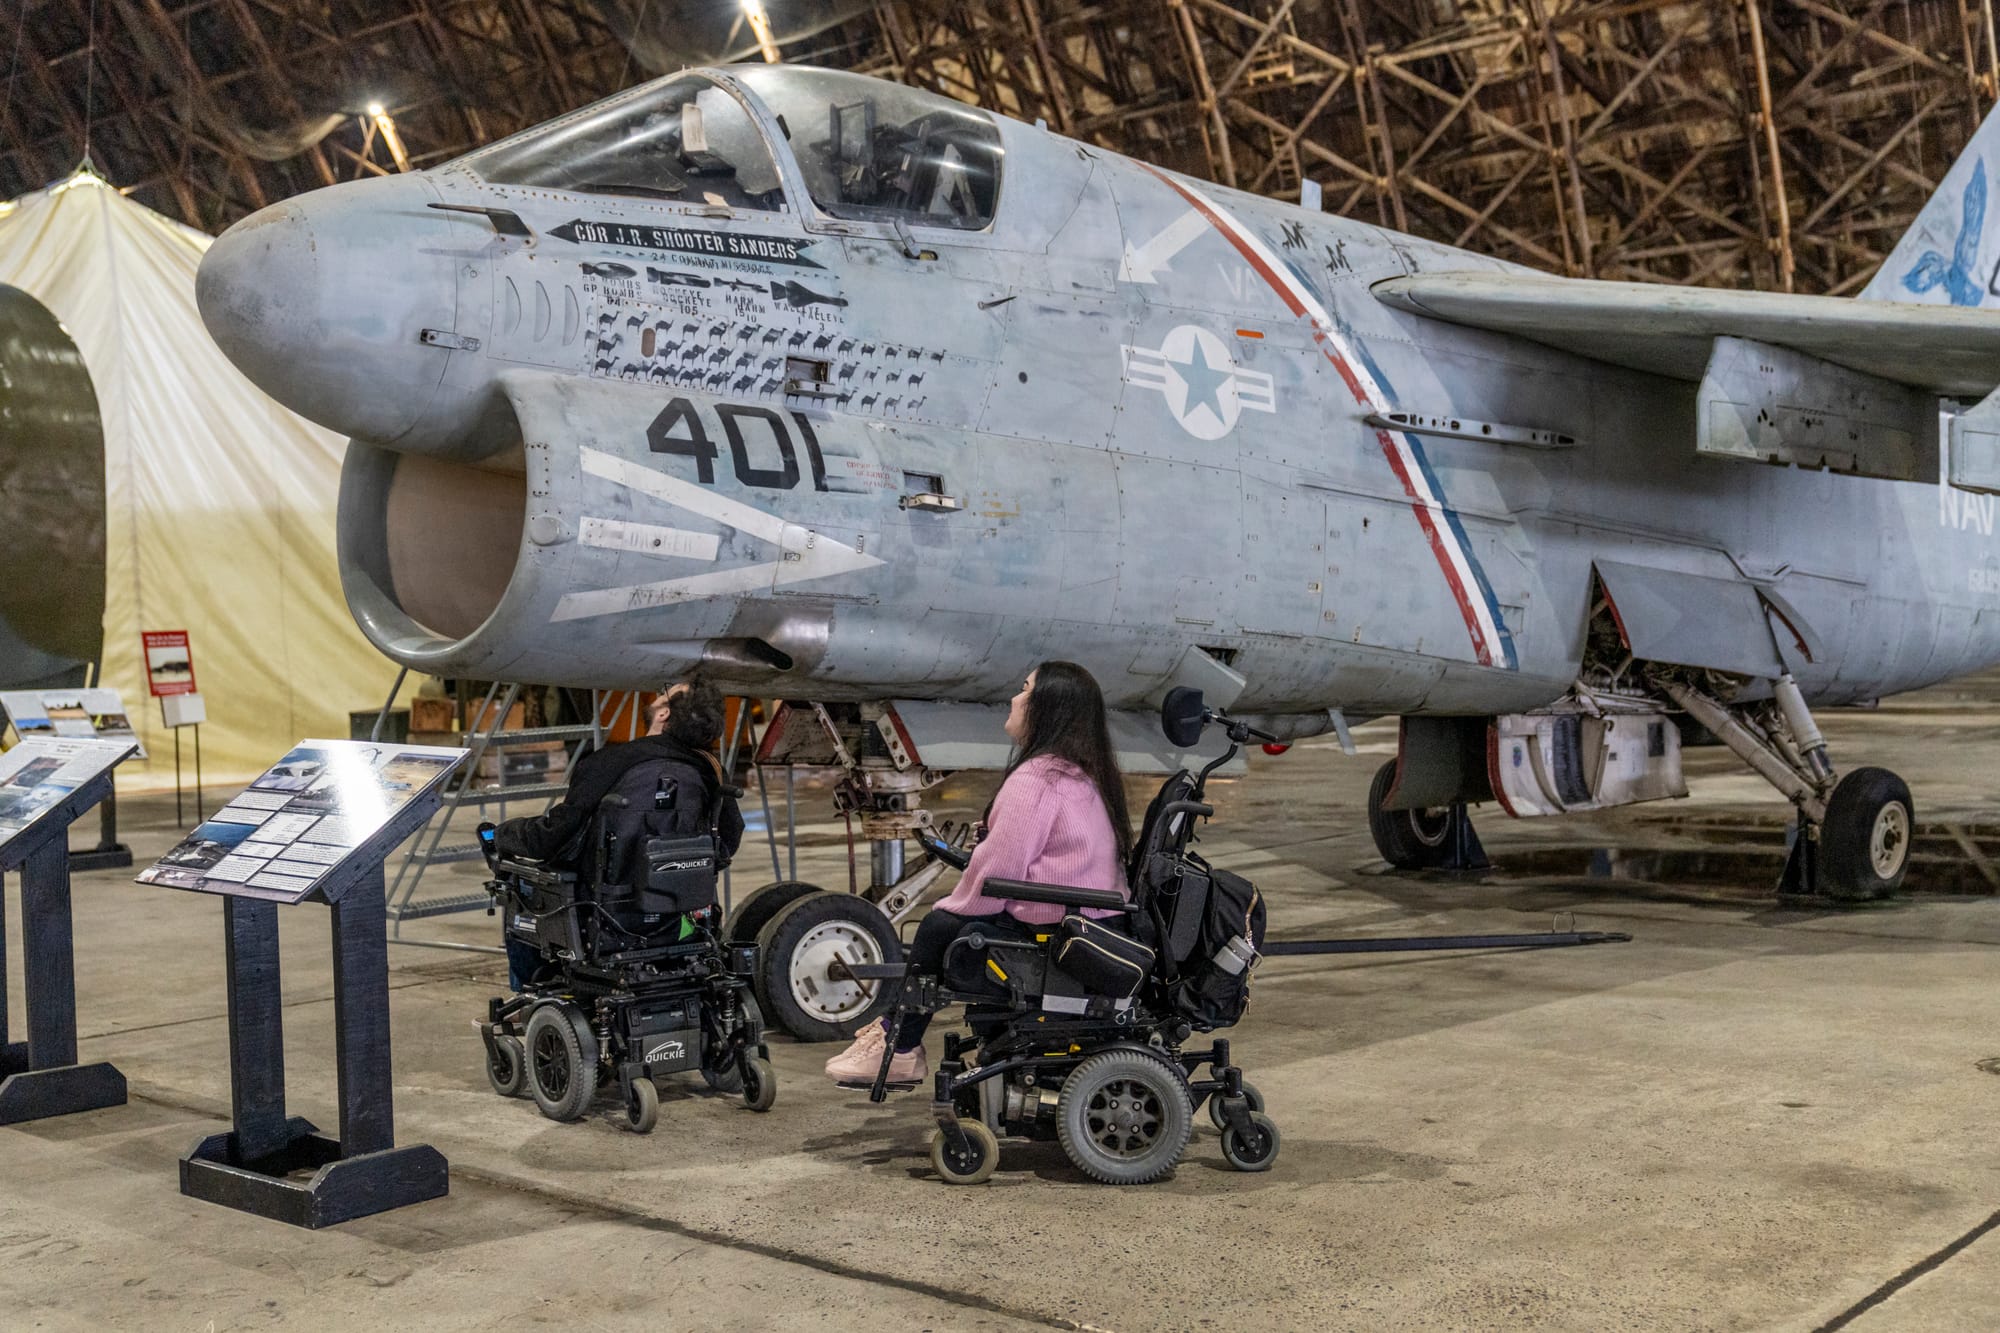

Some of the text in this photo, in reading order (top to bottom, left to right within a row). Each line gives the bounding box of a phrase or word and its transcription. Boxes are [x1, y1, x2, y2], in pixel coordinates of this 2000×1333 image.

[574, 222, 798, 260] CDR J.R. SHOOTER SANDERS
[725, 293, 754, 305] HARM
[680, 304, 699, 315] 105
[646, 396, 829, 492] 401
[680, 859, 708, 869] QUICKIE
[645, 1049, 686, 1064] QUICKIE
